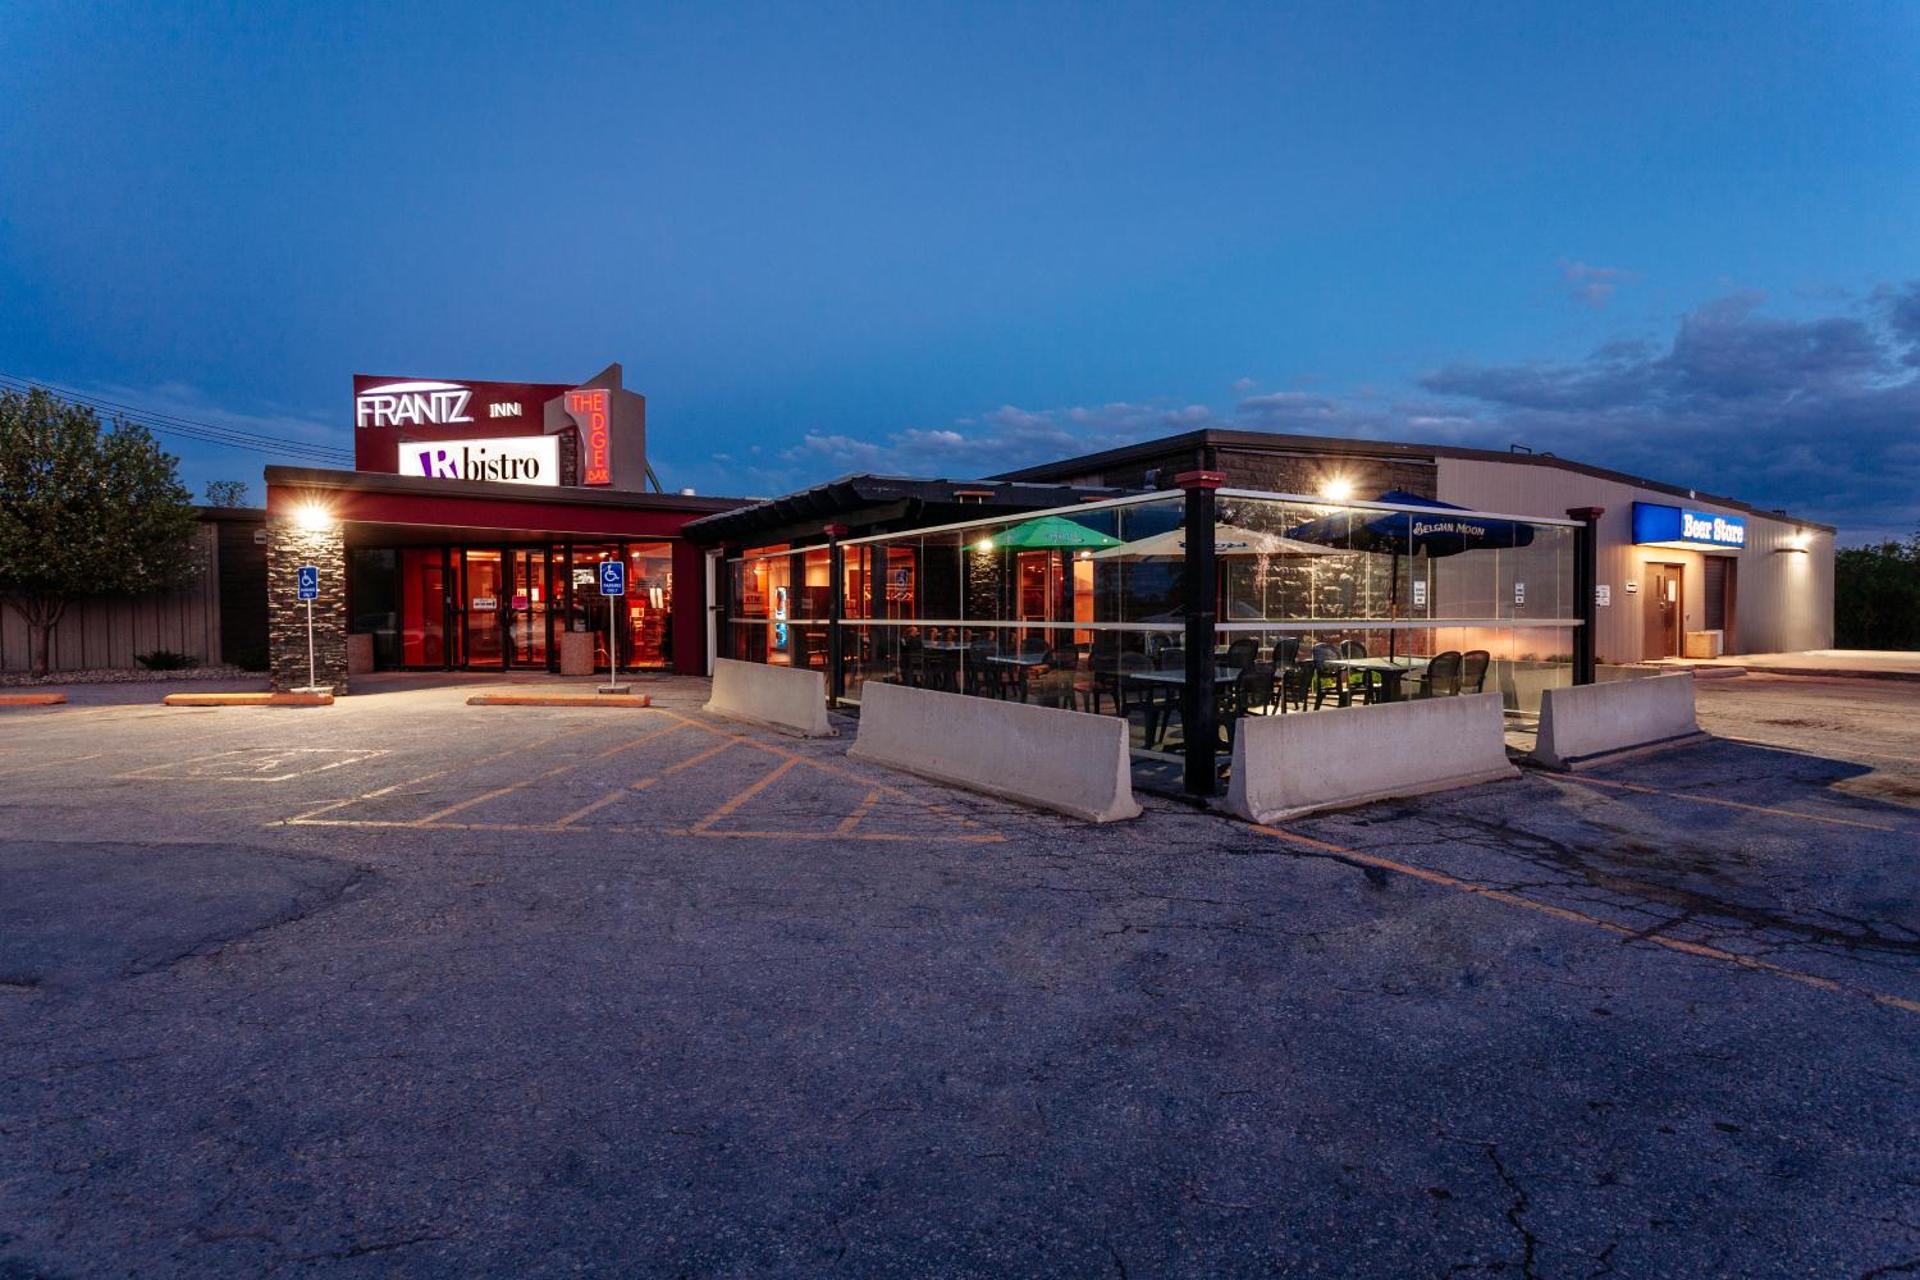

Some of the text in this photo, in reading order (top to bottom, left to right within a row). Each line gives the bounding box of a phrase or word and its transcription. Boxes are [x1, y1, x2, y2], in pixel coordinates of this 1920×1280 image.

[357, 391, 522, 428] FRANTZ INN
[571, 393, 603, 412] THE
[463, 447, 540, 480] bistro
[1456, 523, 1485, 541] MOON
[1683, 514, 1744, 543] Beer Store
